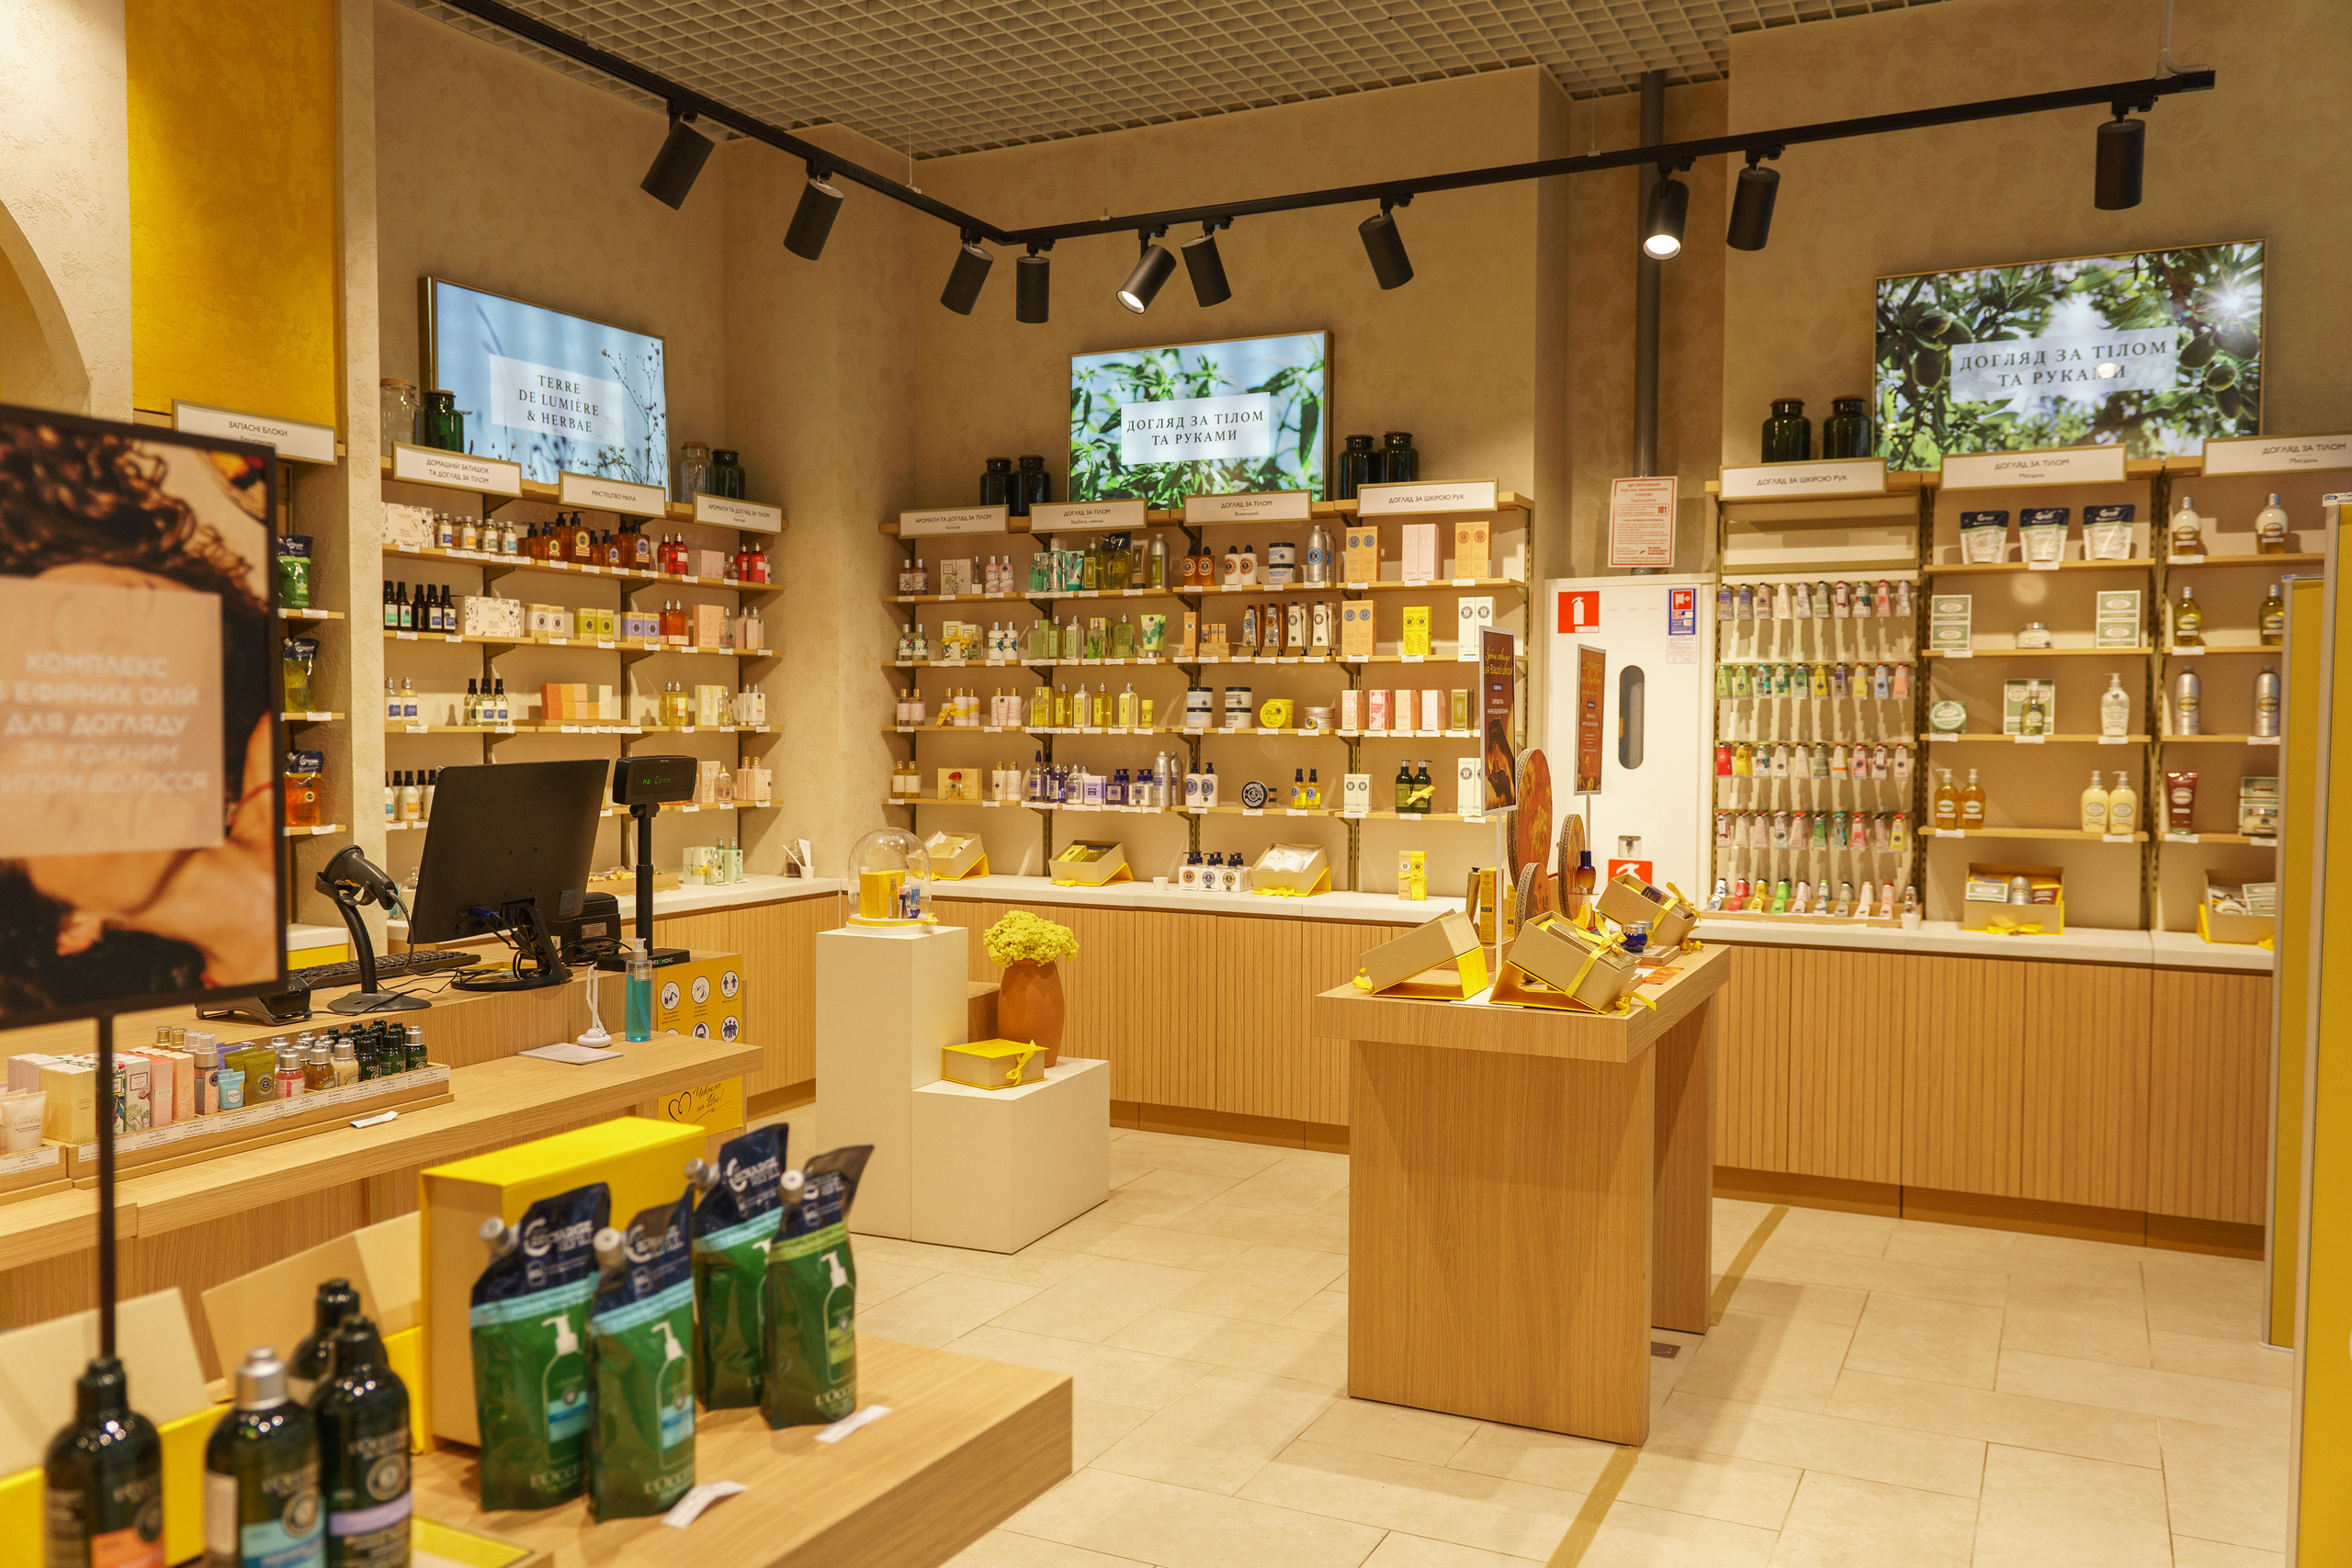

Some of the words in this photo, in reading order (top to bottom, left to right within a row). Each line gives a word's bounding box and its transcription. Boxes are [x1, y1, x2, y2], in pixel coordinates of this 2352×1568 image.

[1960, 349, 2047, 373] ДОГЛЯД
[2056, 347, 2083, 363] ЗА
[2091, 340, 2168, 359] ТІЛОМ
[537, 374, 581, 395] TERRE
[1997, 374, 2023, 388] ТА
[2032, 364, 2127, 385] РУКАИ
[518, 389, 537, 403] DE
[541, 392, 600, 417] LUMIÈRE
[228, 421, 261, 434] ЗАПАСНІ
[263, 426, 288, 437] БЛОКИ
[526, 410, 537, 423] &
[541, 412, 593, 434] HERBAE
[1126, 415, 1185, 433] ДОГЛЯД
[1190, 414, 1209, 427] ЗА
[1214, 410, 1264, 425] ТІЛОМ
[1151, 434, 1170, 446] ТА
[1174, 429, 1238, 445] РУКАМИ
[2262, 444, 2301, 456] ДОГЛЯД
[2301, 445, 2314, 453] ЗА
[2315, 442, 2347, 452] ТІЛОМ
[426, 458, 460, 470] ДОМАШНІЙ
[460, 463, 490, 475] ЗАТИШОК
[1994, 460, 2030, 470] ДОГЛЯД
[2030, 460, 2041, 468] ЗА
[2042, 458, 2070, 468] ТІЛОМ
[437, 470, 461, 481] ДОГЛЯД
[470, 476, 490, 484] ТІЛОМ
[1757, 476, 1788, 487] ДОГЛЯД
[1799, 475, 1832, 484] ШКІРОЮ
[1833, 474, 1849, 482] РУК
[591, 490, 621, 502] МИСТЕЦТВО
[621, 494, 637, 502] МИЛА
[1221, 501, 1245, 509] ДОГЛЯД
[1253, 499, 1272, 507] ТІЛОМ
[1387, 495, 1414, 504] ДОГЛЯД
[1414, 494, 1423, 502] ЗА
[1424, 493, 1451, 502] ШКІРОЮ
[1452, 492, 1464, 502] РУК
[707, 503, 728, 513] АРОМАТИ
[734, 508, 752, 517] ДОГЛЯД
[757, 511, 771, 519] ТІЛОМ
[1063, 509, 1086, 517] ДОГЛЯД
[1092, 508, 1111, 516] ТІЛОМ
[1657, 506, 1668, 514] 101
[915, 516, 940, 525] АРОМАТИ
[947, 515, 968, 524] ДОГЛЯД
[26, 651, 168, 678] КОМПЛЕКС
[14, 682, 133, 705] ЕФІРНИХ
[139, 683, 199, 706] ОЛІЙ
[4, 713, 65, 736] ДЛЯ
[70, 713, 189, 738] ДОГЛЯДУ
[20, 743, 57, 764] ЗА
[62, 744, 179, 765] КОЖНИМ
[88, 772, 209, 794] ВОЛОССЯ
[693, 1082, 722, 1099] Чекаємо
